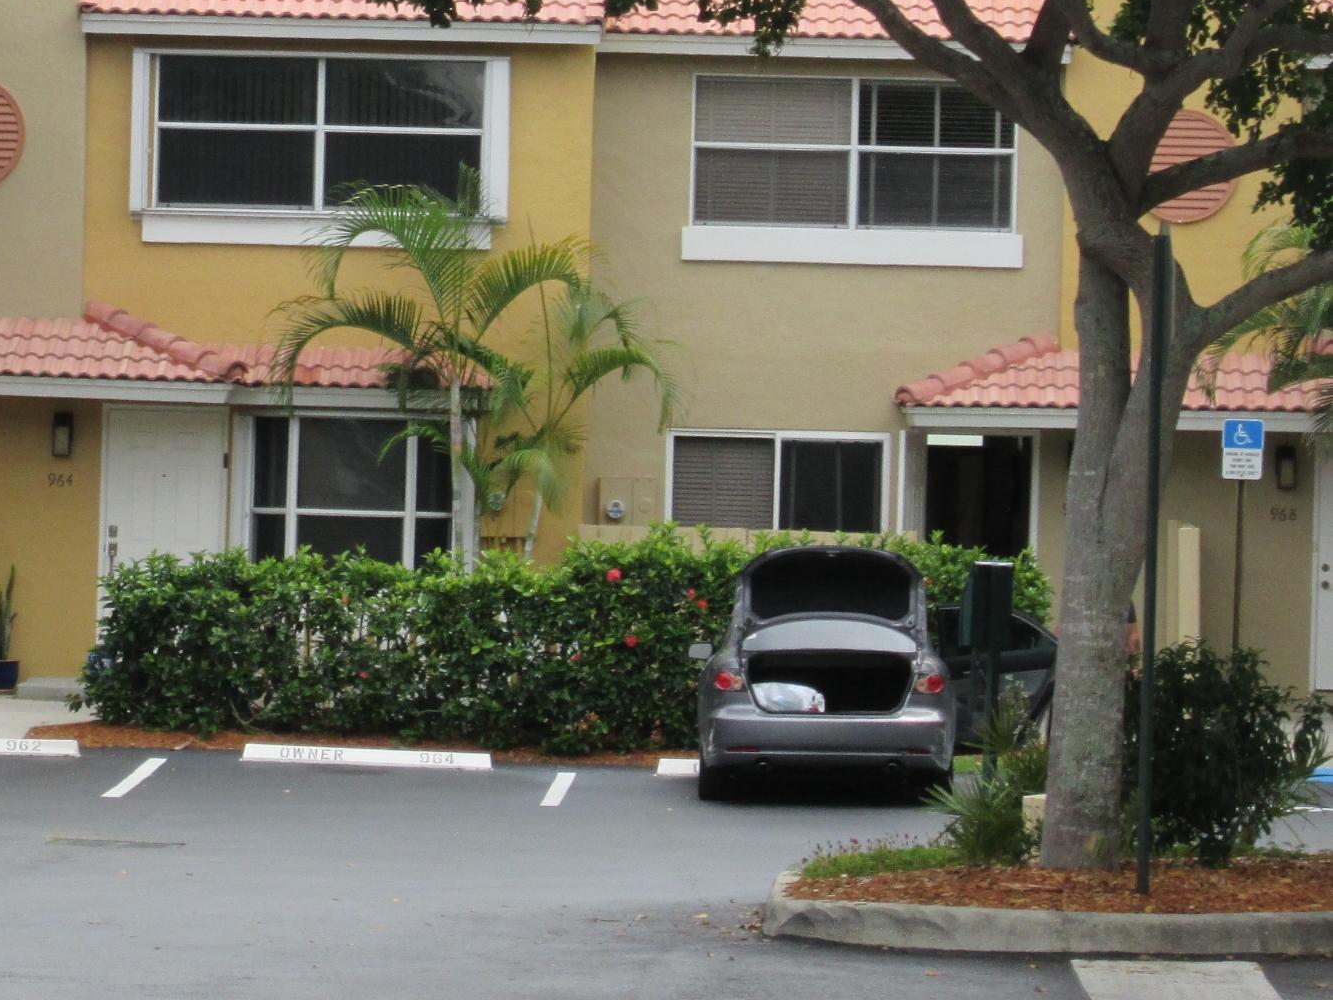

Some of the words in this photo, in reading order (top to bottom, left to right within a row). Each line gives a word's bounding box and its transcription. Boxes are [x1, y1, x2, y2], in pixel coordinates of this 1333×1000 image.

[48, 472, 73, 488] 964
[1270, 507, 1298, 521] 968
[6, 739, 43, 752] 962
[280, 746, 344, 761] OWNER
[419, 752, 454, 765] 964
